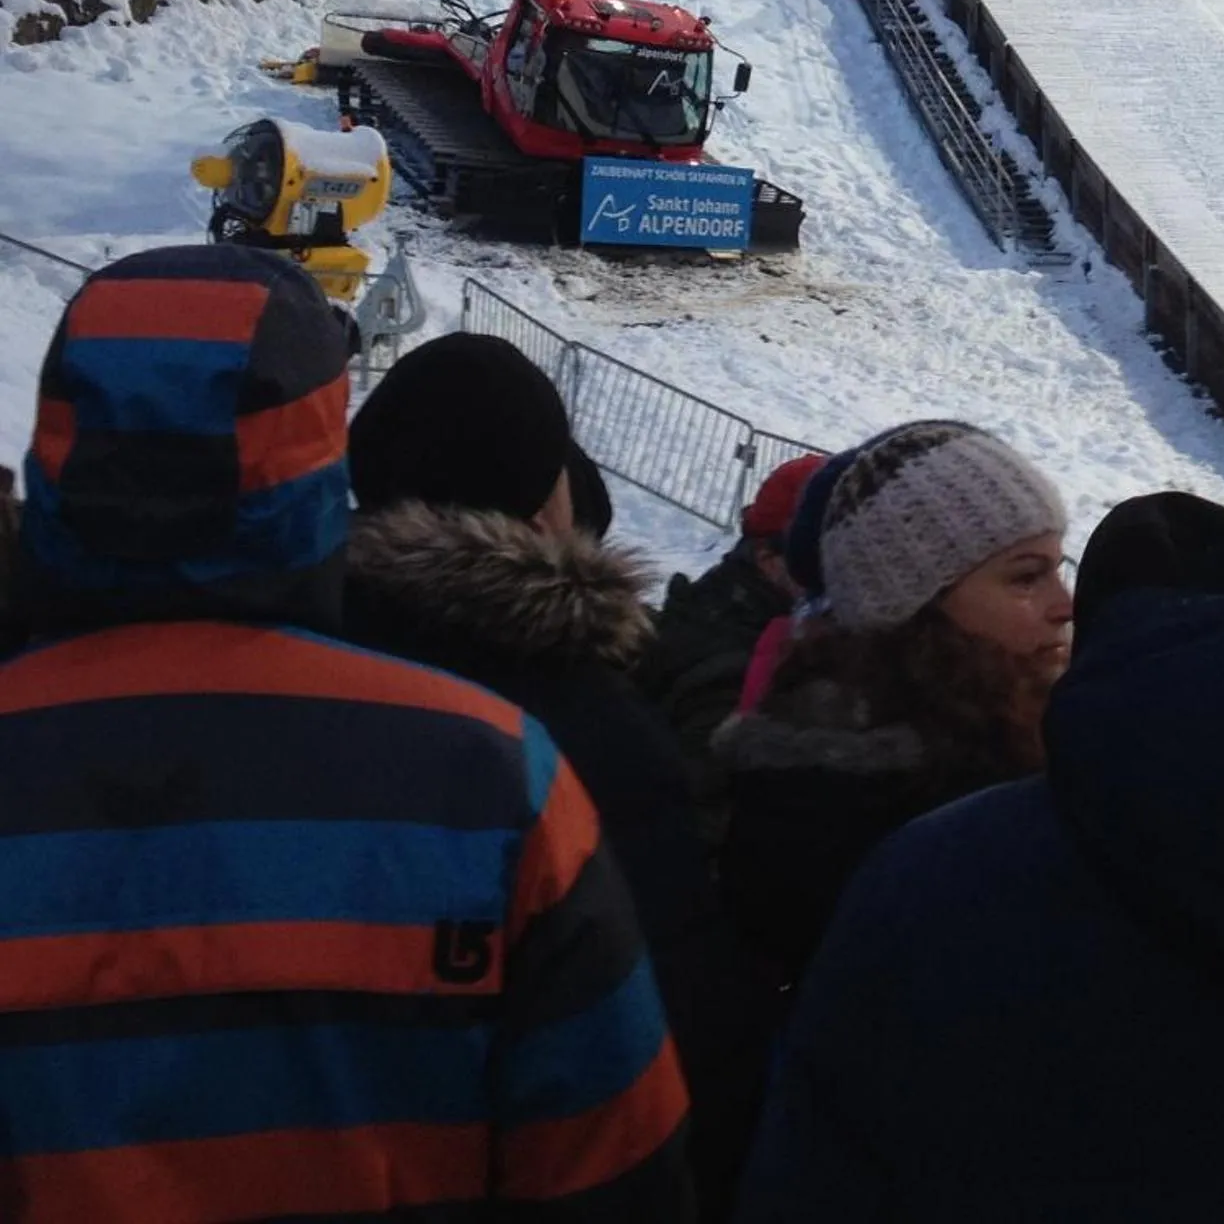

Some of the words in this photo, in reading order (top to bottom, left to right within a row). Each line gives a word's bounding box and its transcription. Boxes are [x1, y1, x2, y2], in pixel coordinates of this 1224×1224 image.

[648, 194, 688, 212] Sankt
[692, 197, 740, 215] Johann
[638, 215, 745, 238] ALPENDORF
